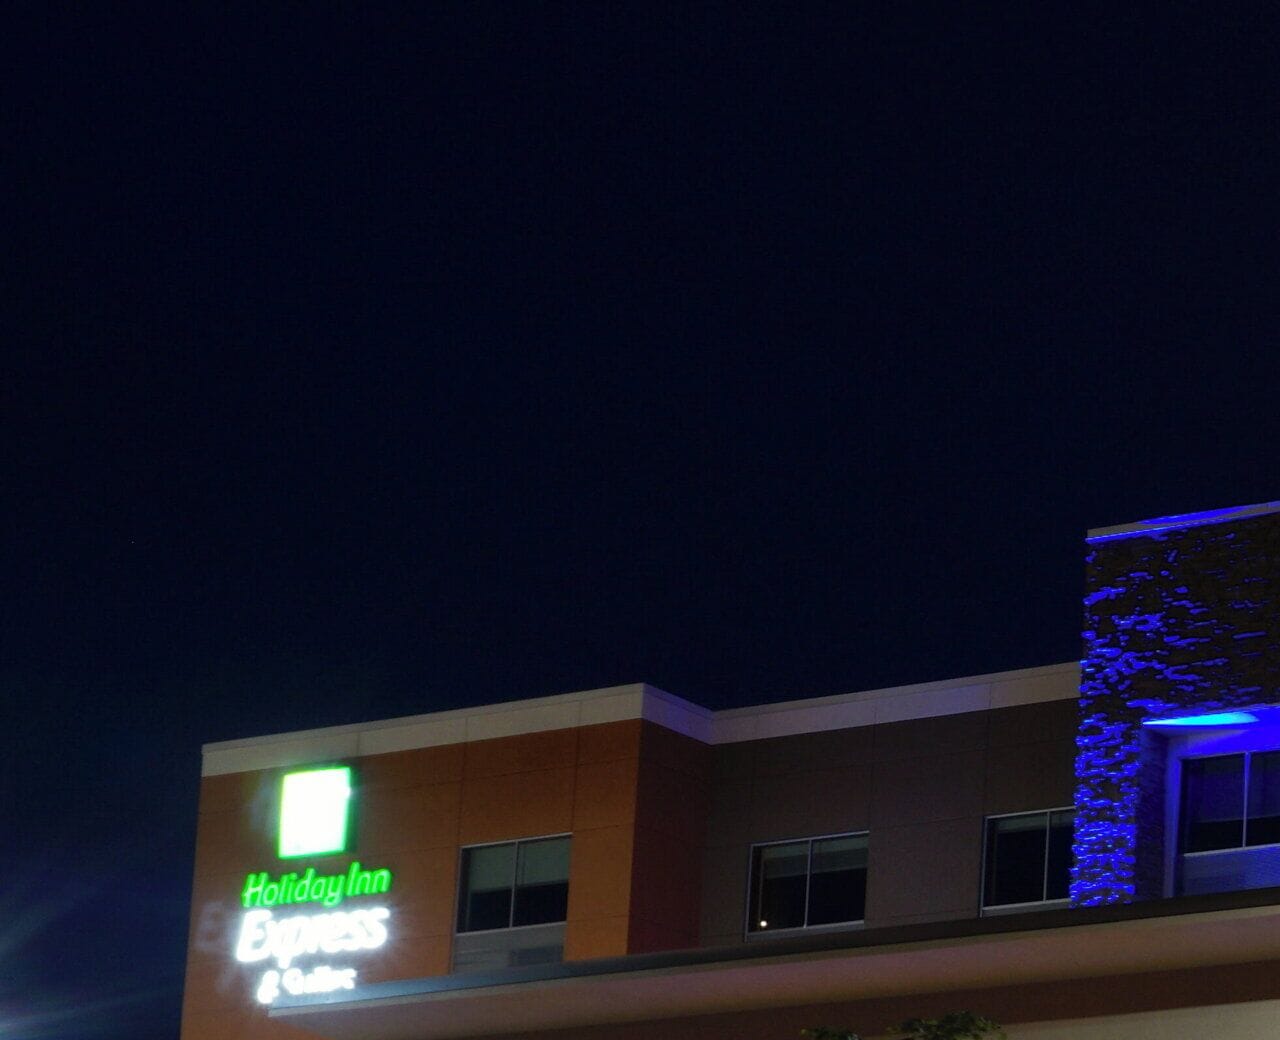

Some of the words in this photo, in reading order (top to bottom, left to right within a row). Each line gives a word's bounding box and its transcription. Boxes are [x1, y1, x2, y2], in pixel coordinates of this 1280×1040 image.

[242, 867, 345, 907] Holiday
[346, 861, 392, 897] Inn
[236, 907, 390, 969] Express
